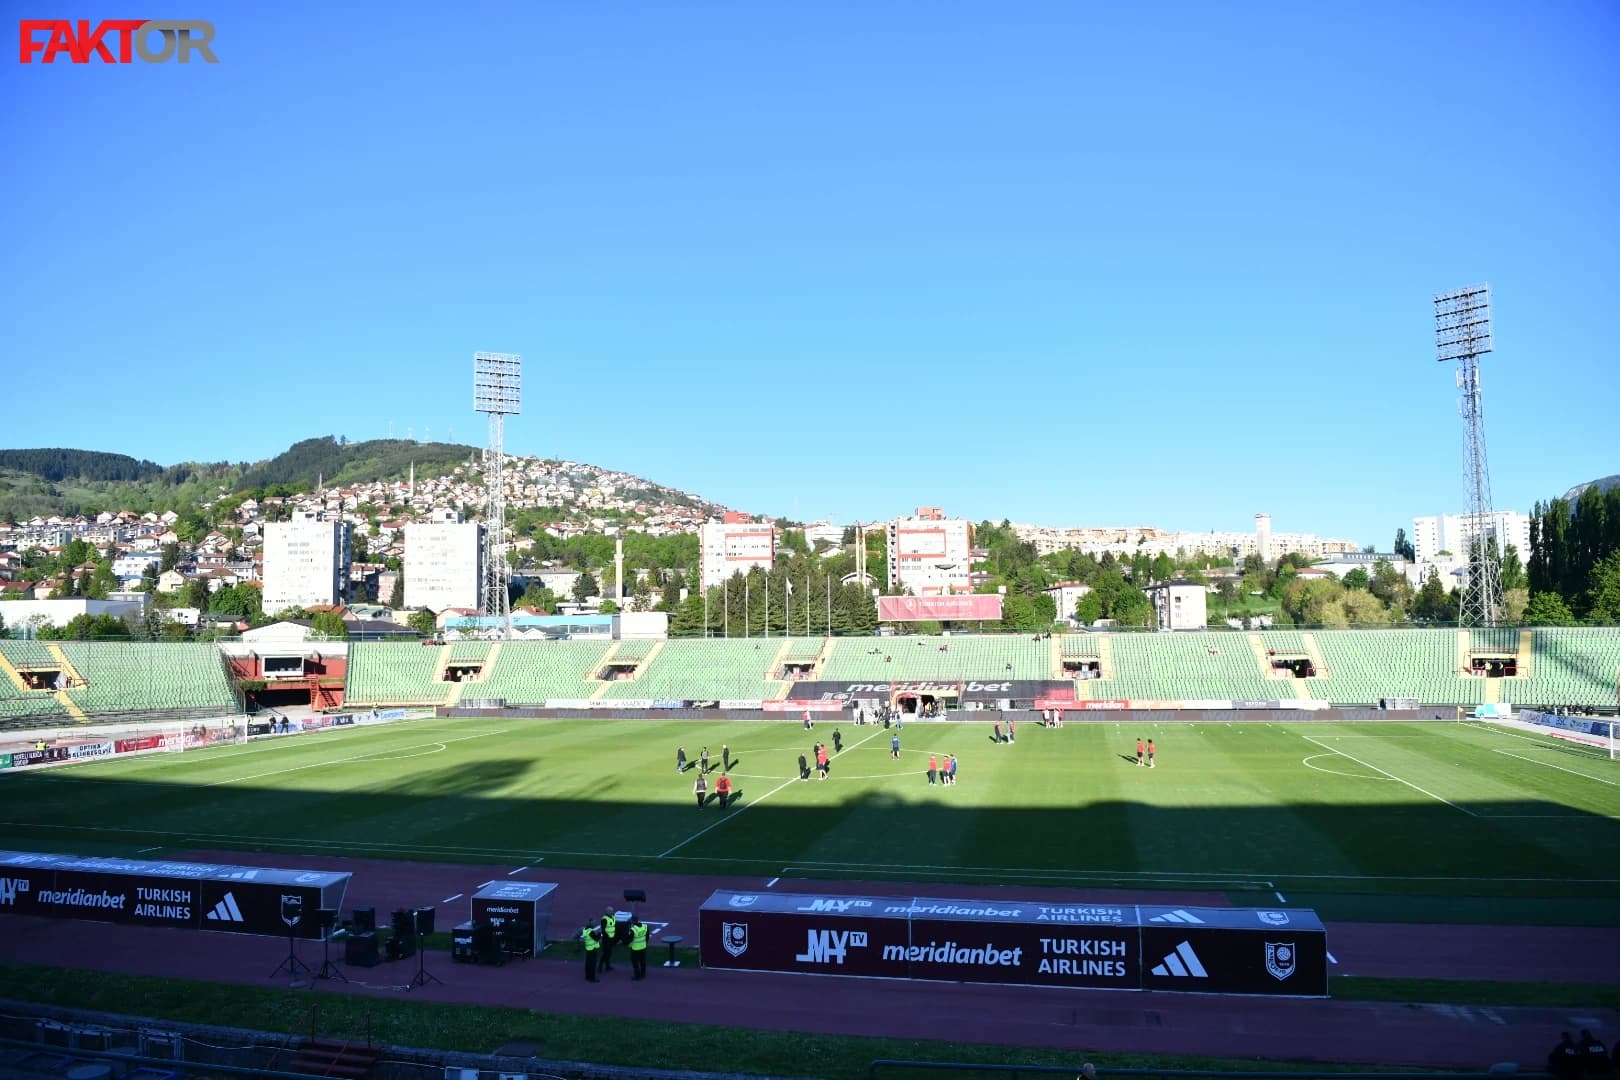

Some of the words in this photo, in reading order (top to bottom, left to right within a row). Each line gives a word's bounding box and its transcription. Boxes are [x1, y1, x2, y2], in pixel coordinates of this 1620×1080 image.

[847, 681, 1012, 693] meridianbet
[37, 887, 126, 909] meridianbet
[136, 887, 192, 903] TURKISH
[134, 904, 192, 920] AIRLINES
[486, 906, 520, 914] meridianbet
[884, 904, 1022, 917] meridianbet
[1036, 914, 1122, 922] AIRLINES
[1039, 907, 1122, 915] TURKISH
[882, 940, 1023, 966] meridianbet
[1039, 938, 1126, 957] TURKISH
[1038, 959, 1126, 977] AIRLINES
